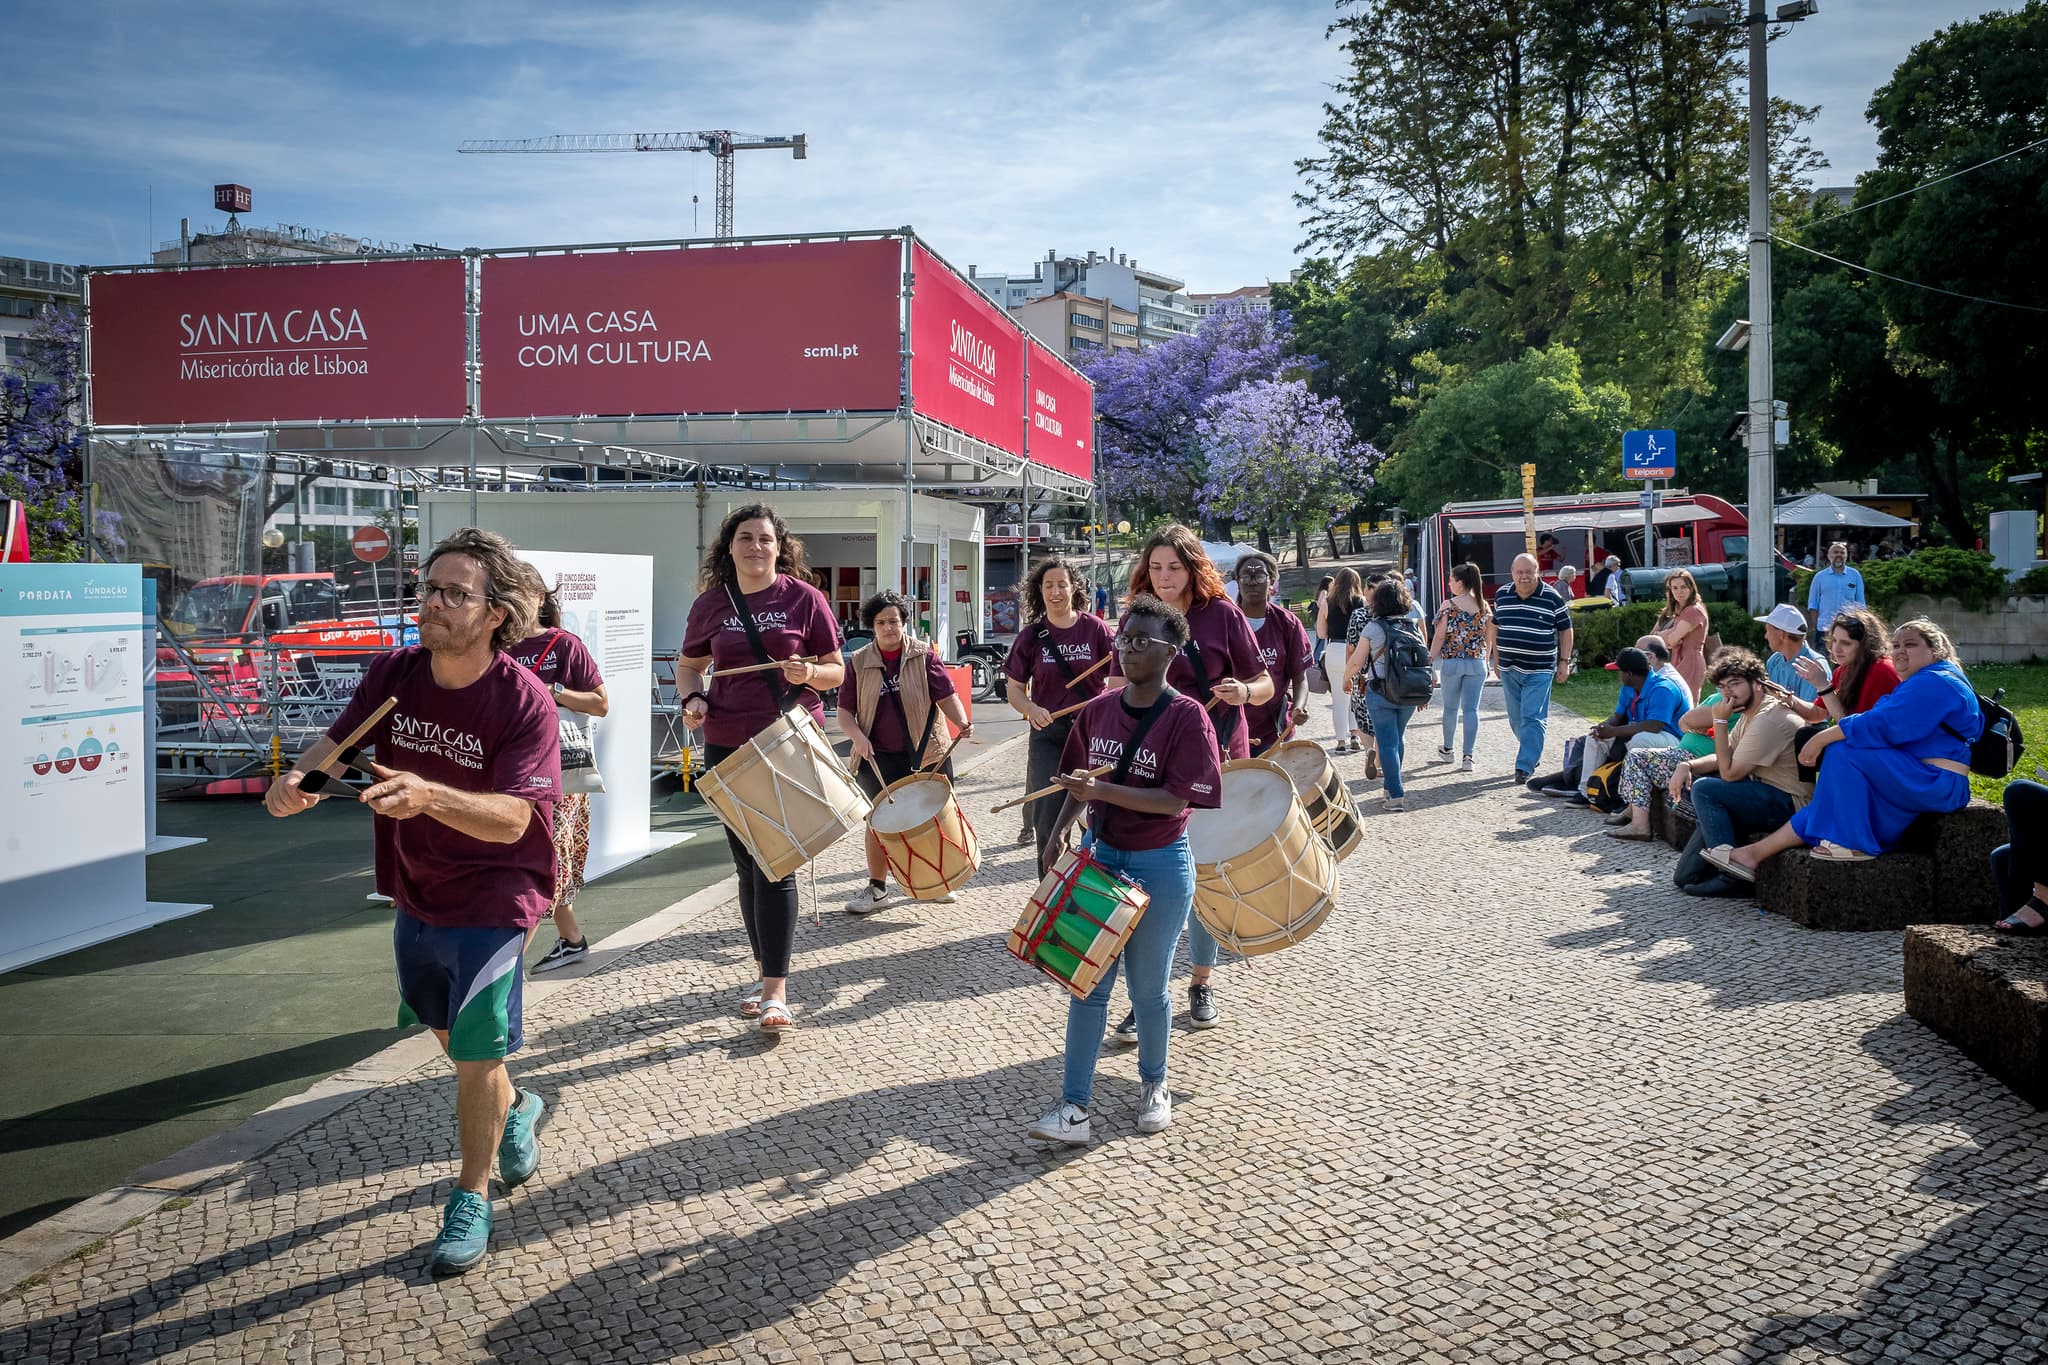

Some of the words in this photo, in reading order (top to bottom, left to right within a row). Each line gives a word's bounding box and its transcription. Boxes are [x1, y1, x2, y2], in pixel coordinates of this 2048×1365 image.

[216, 190, 233, 203] HF
[235, 190, 251, 205] HF
[180, 312, 278, 348] SANTA
[283, 307, 368, 344] CASA
[519, 313, 580, 336] UMA
[586, 310, 658, 334] CASA
[518, 344, 578, 368] COM
[587, 340, 712, 365] CULTURA
[804, 343, 859, 360] scml.pt
[950, 319, 977, 367] SANTA
[976, 339, 996, 378] CASA
[180, 356, 284, 381] Misericórdia
[288, 355, 310, 377] de
[314, 354, 369, 376] Lisboa
[981, 382, 995, 407] Lisboa
[1036, 388, 1046, 408] UMA
[1045, 394, 1056, 414] CASA
[1634, 468, 1665, 477] telpark
[19, 590, 72, 600] PORDATA
[84, 585, 128, 596] FUNDAÇÃO
[1261, 647, 1278, 658] ASA
[392, 713, 441, 741] SANTA
[443, 728, 484, 756] CASA
[391, 734, 442, 757] Miseriórdia
[454, 752, 483, 770] Lisboa
[1090, 737, 1123, 756] SANTA
[1133, 746, 1157, 768] ASA
